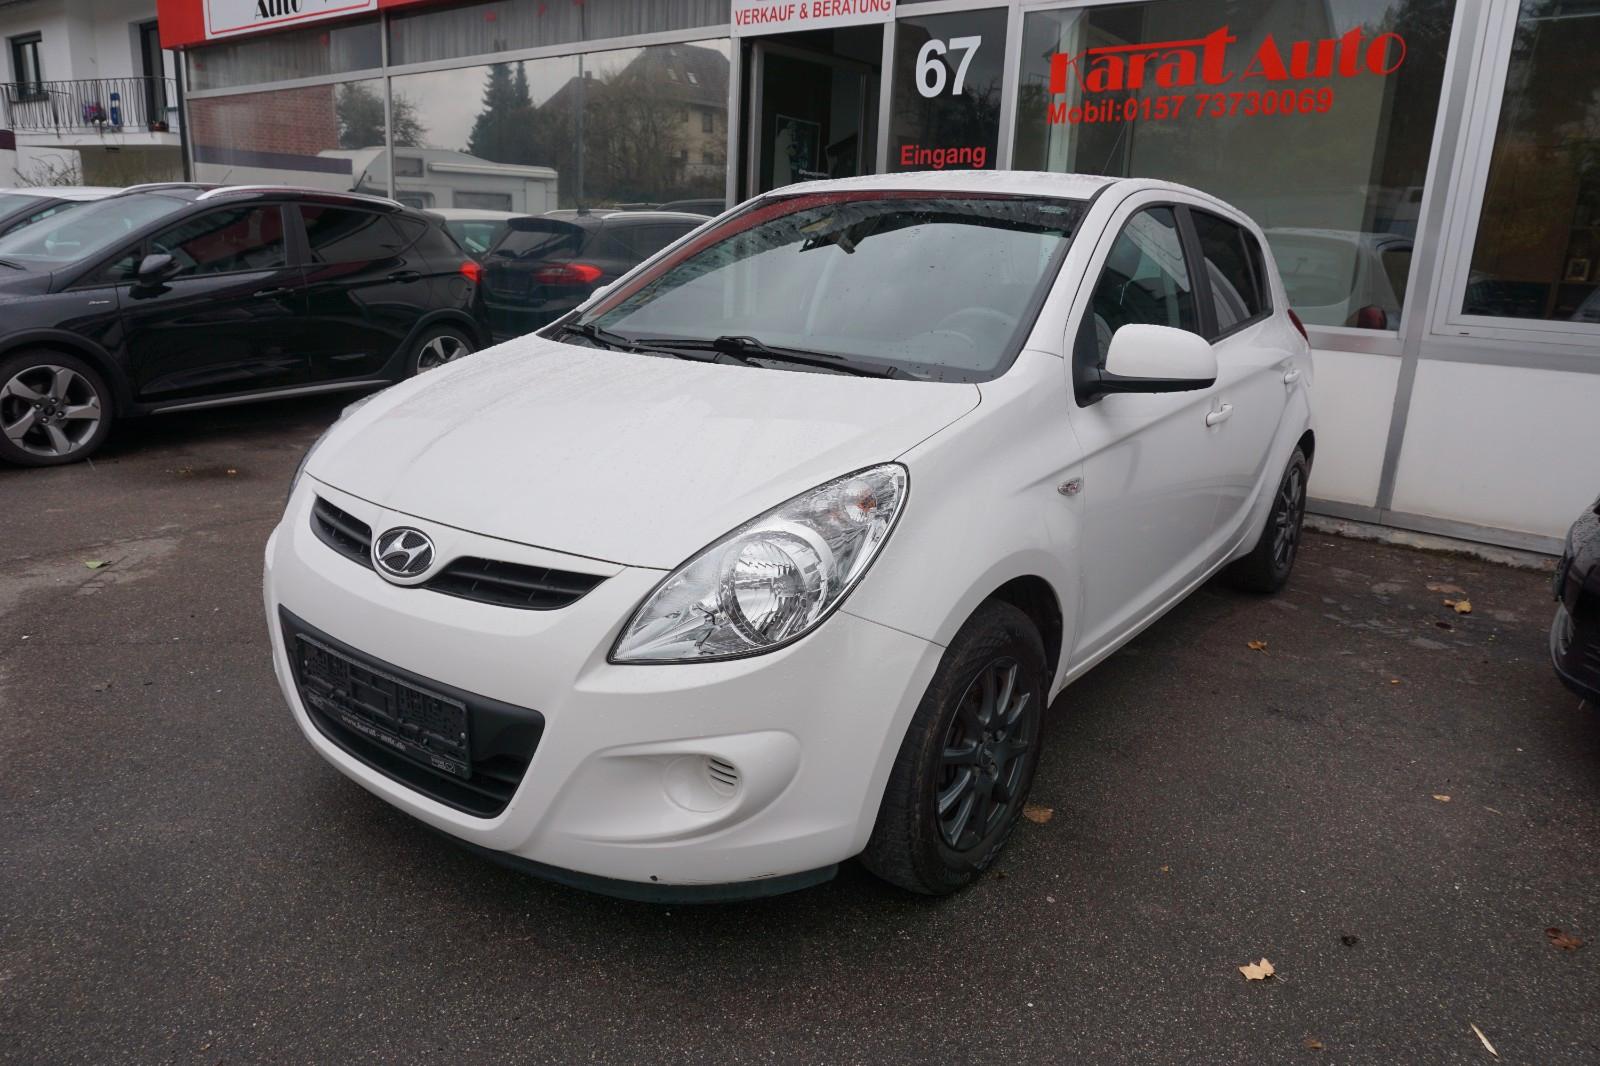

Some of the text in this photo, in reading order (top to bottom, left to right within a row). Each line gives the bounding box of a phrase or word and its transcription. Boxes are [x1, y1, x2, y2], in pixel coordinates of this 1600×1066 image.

[735, 0, 891, 26] VERKAUF & BERATUNG
[915, 35, 982, 98] 67
[1049, 25, 1406, 94] Karat Auto
[1047, 87, 1334, 125] Mobil:0157 73730069
[900, 144, 987, 170] Eingang
